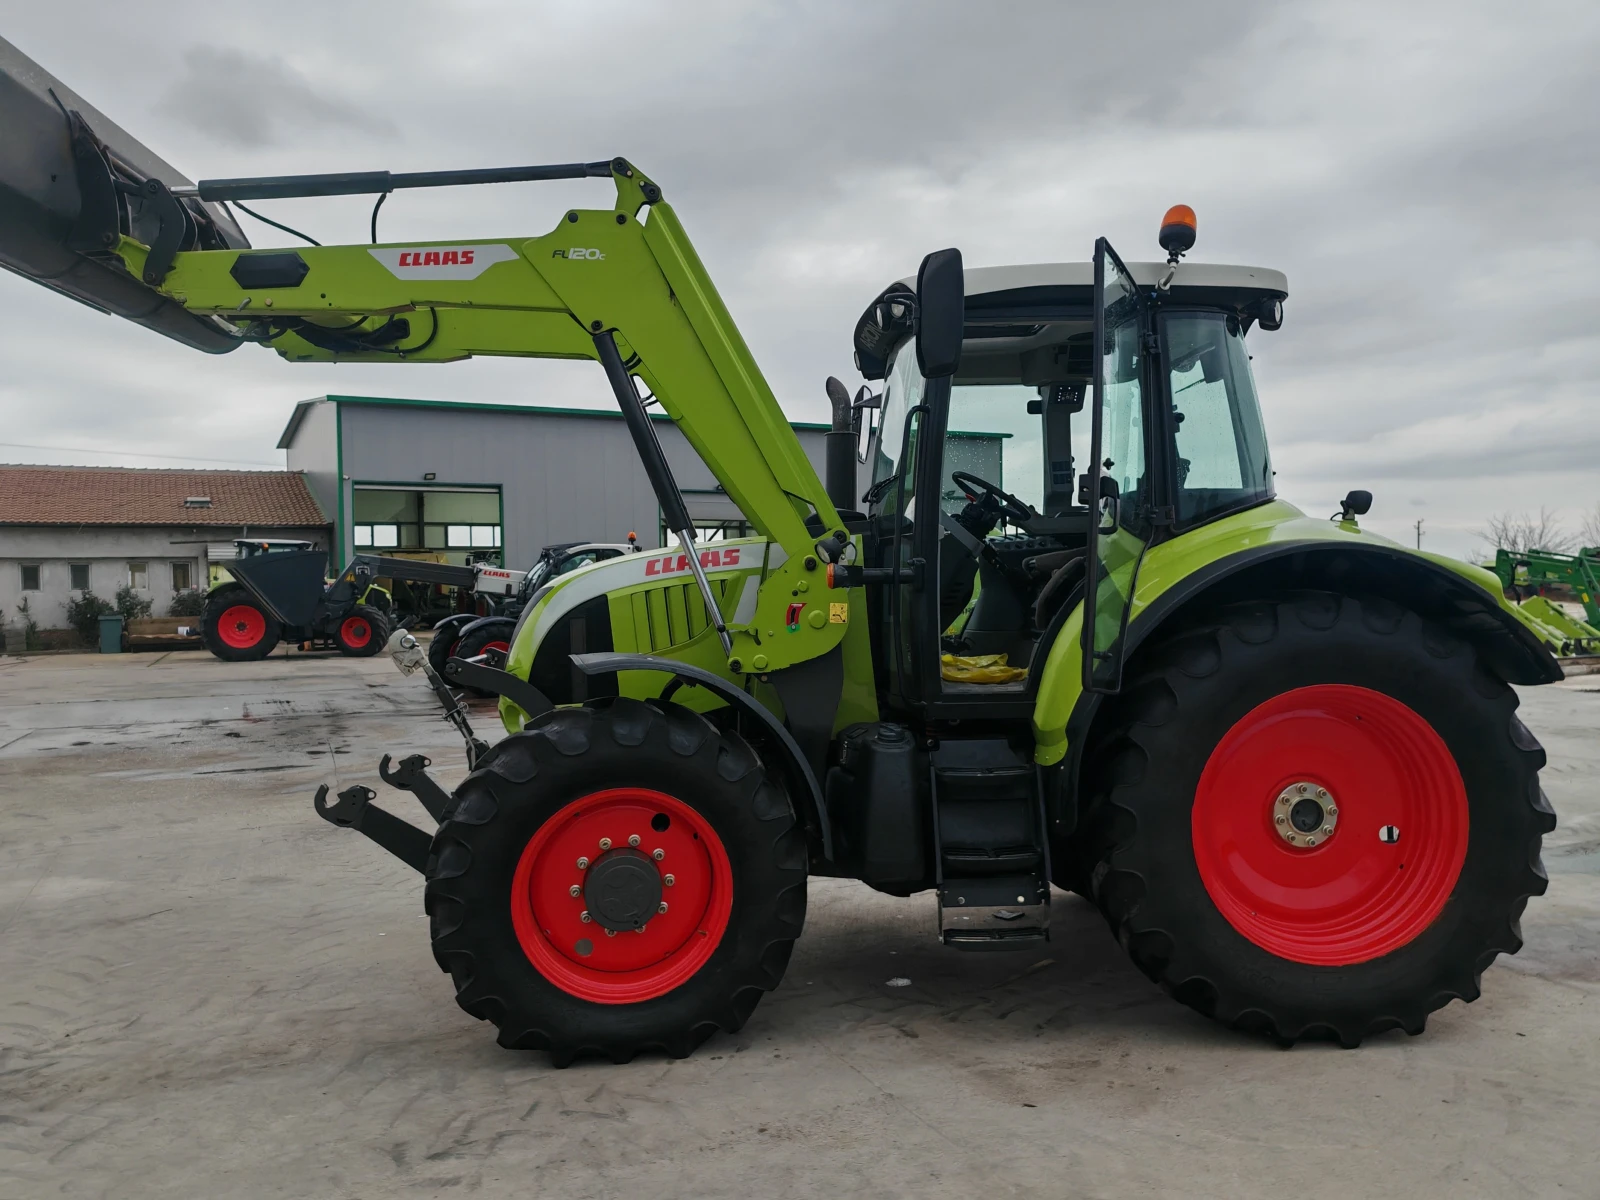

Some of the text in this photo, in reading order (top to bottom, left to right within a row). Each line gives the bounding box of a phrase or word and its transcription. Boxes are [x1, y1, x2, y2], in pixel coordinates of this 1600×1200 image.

[399, 250, 475, 266] CLAAS
[645, 548, 740, 577] CLAAS
[483, 570, 511, 579] CLAAS
